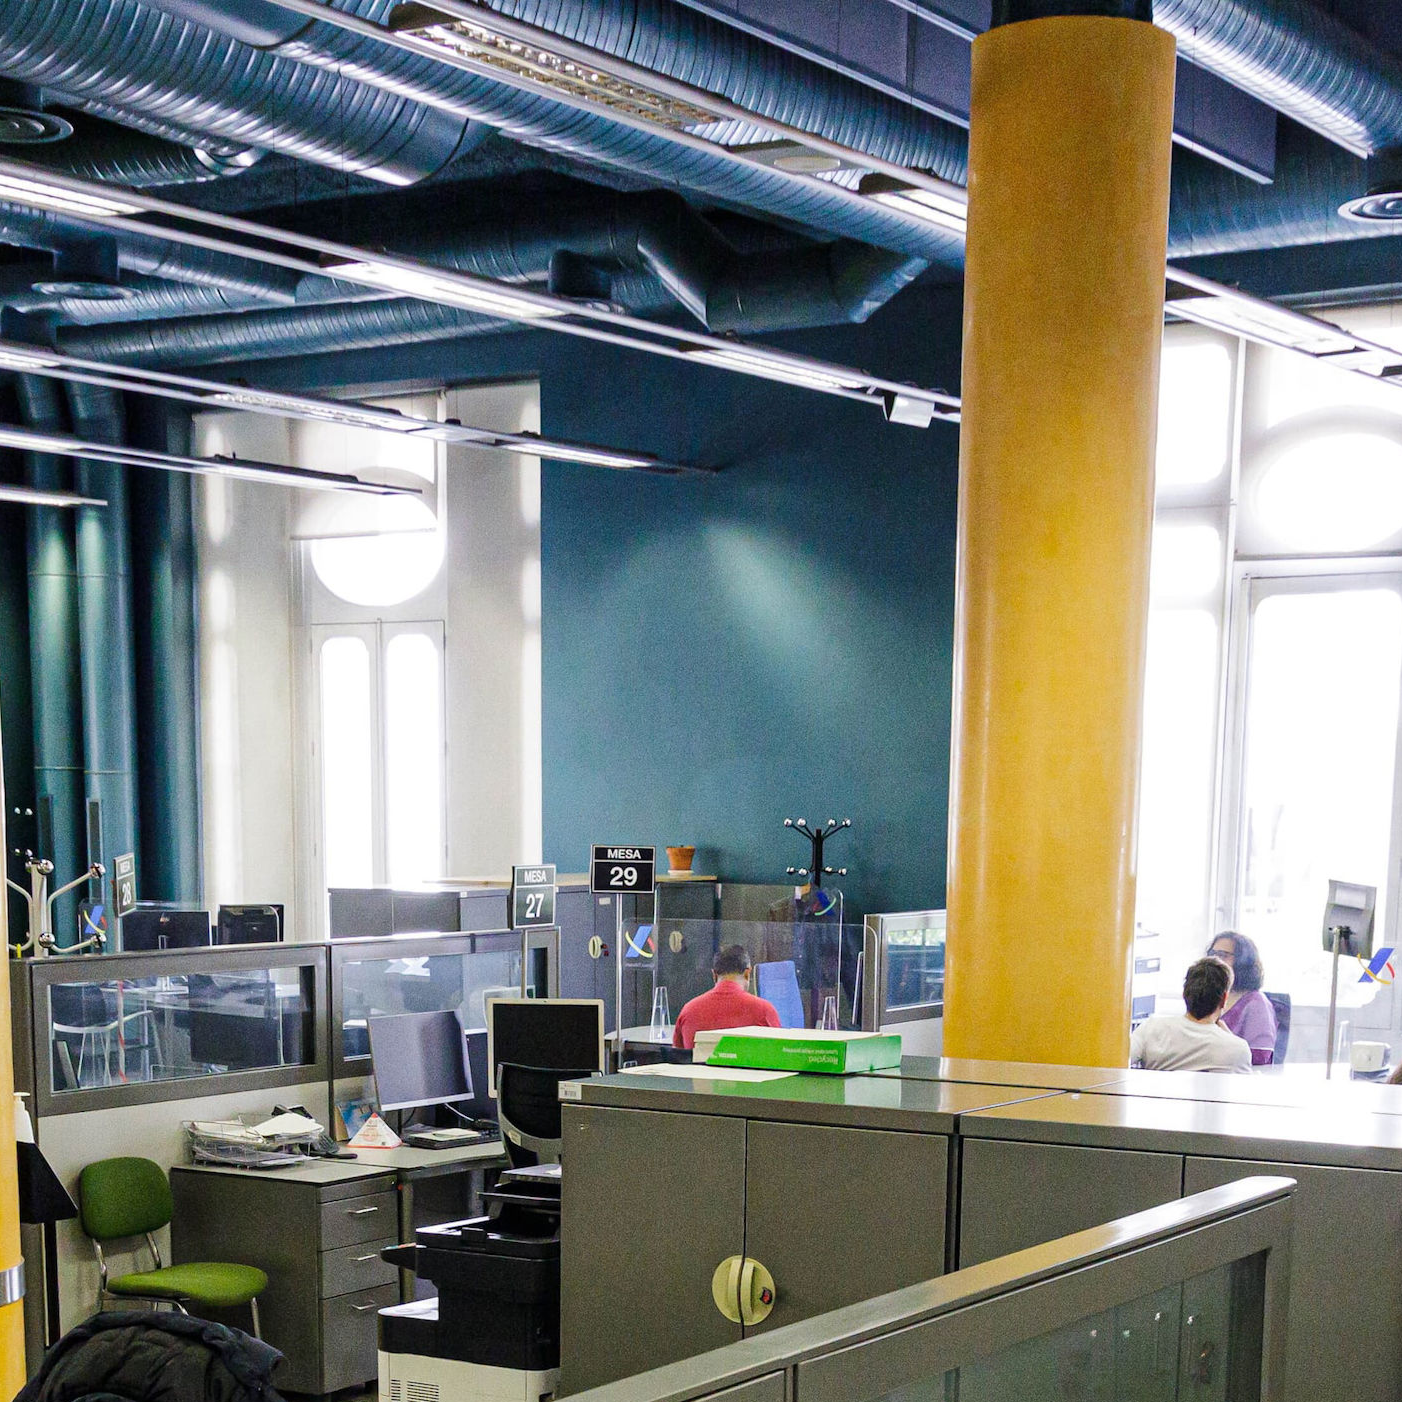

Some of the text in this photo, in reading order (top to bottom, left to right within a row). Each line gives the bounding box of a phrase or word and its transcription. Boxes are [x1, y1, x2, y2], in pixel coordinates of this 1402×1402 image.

[607, 849, 641, 859] MESA
[524, 870, 547, 883] MESA
[609, 866, 637, 886] 29
[121, 882, 132, 906] 28
[525, 893, 545, 918] 27
